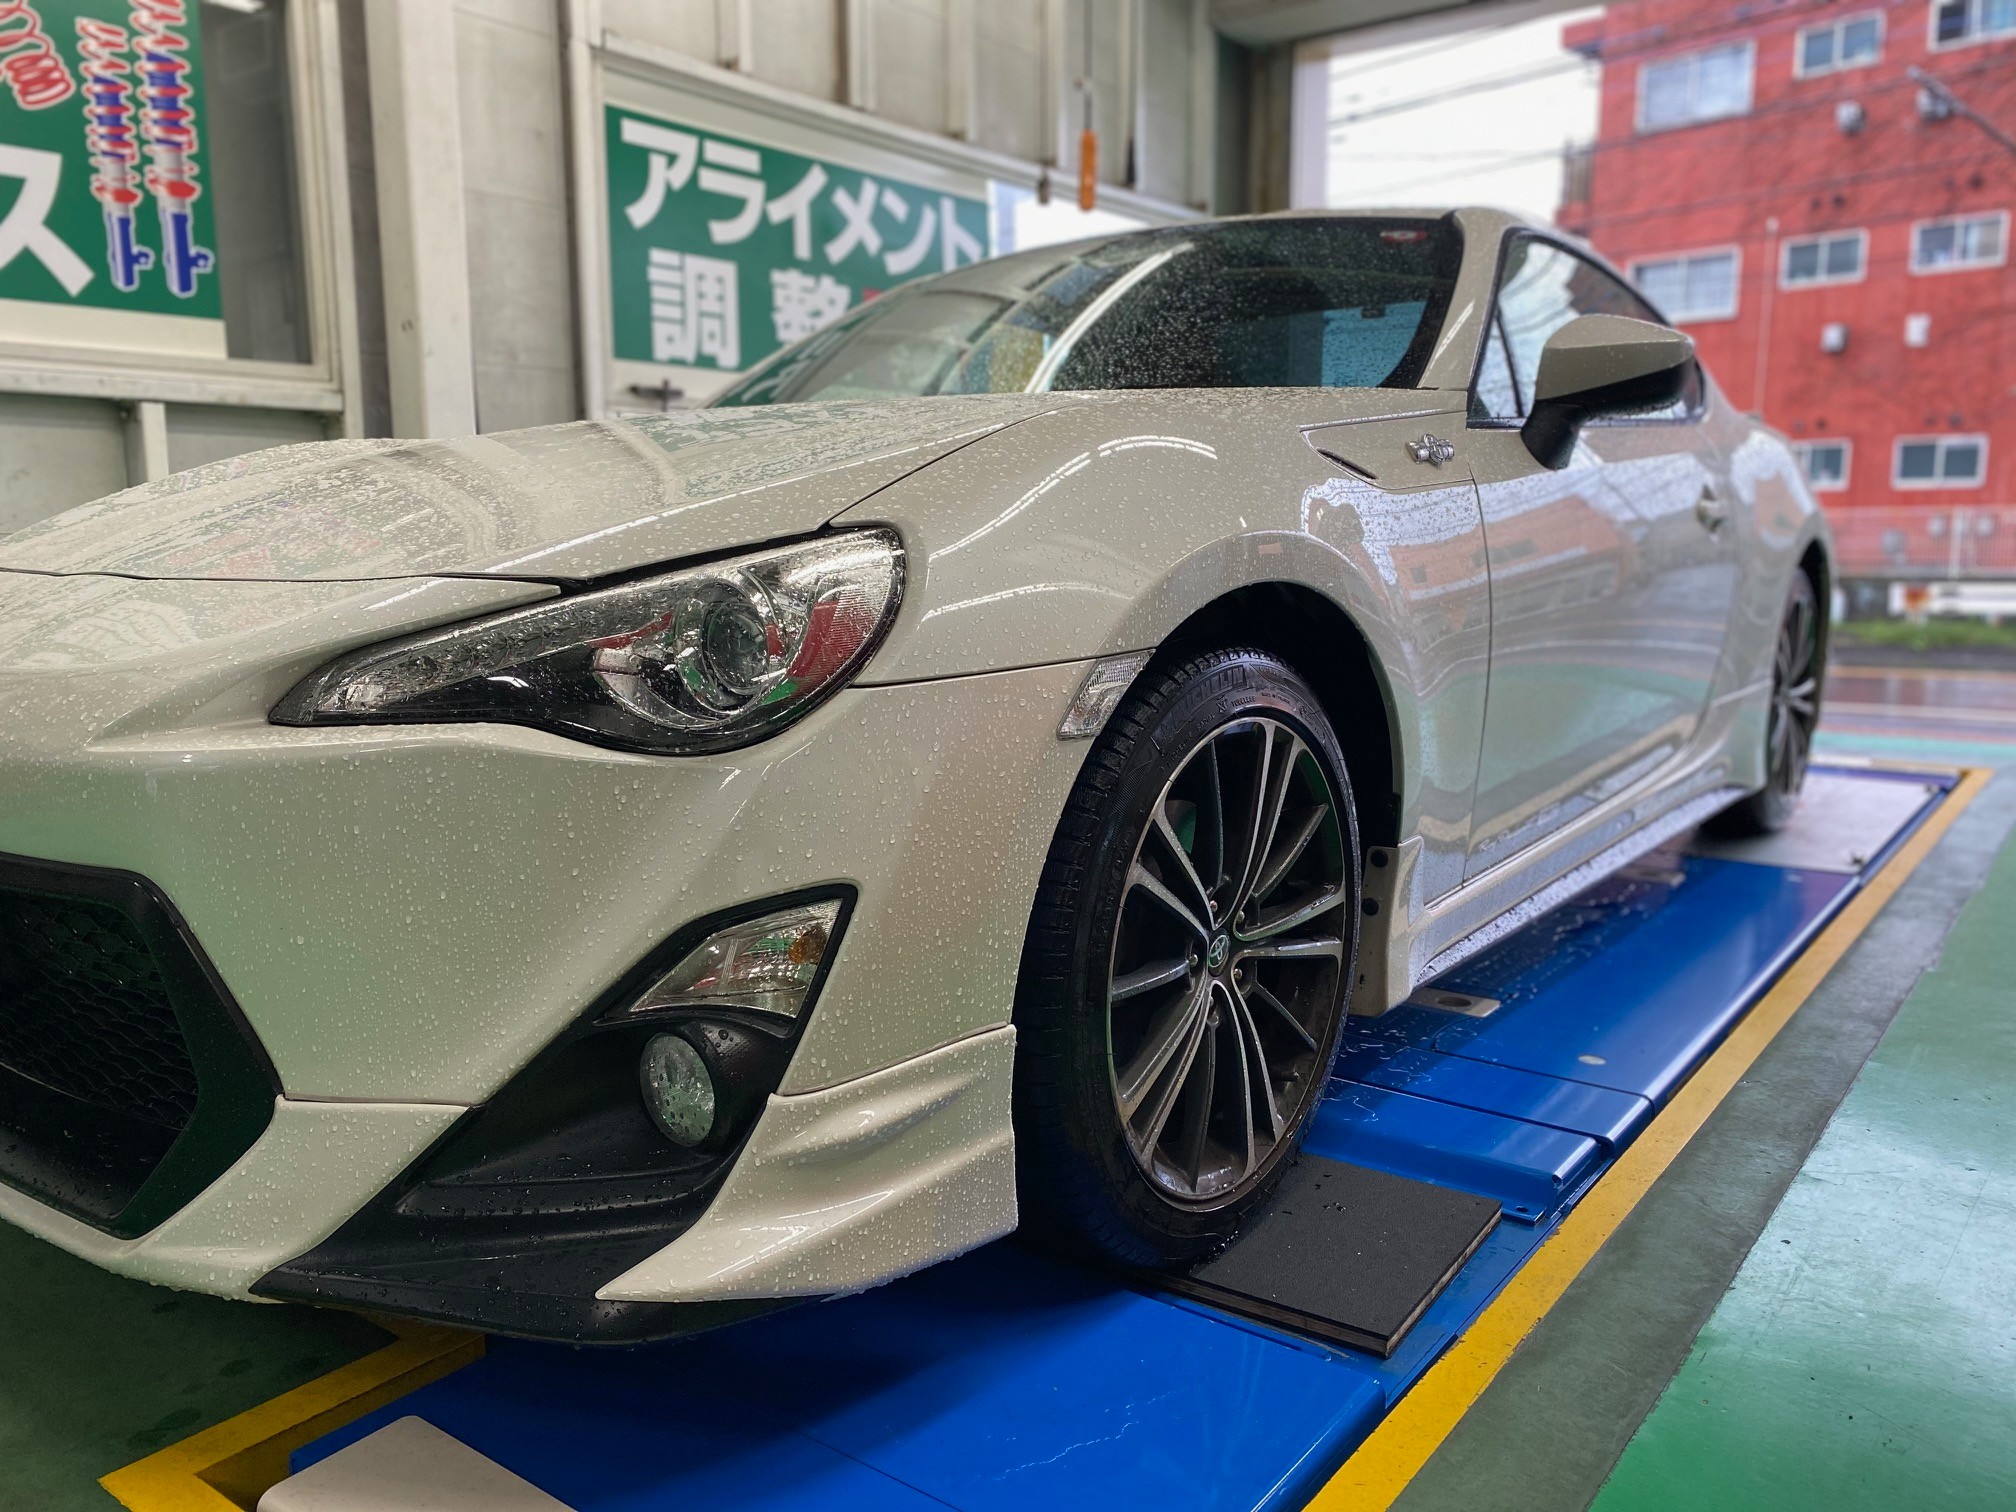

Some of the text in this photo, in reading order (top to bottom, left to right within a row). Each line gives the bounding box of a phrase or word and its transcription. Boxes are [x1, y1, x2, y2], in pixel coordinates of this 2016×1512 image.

[621, 117, 984, 276] アライメント
